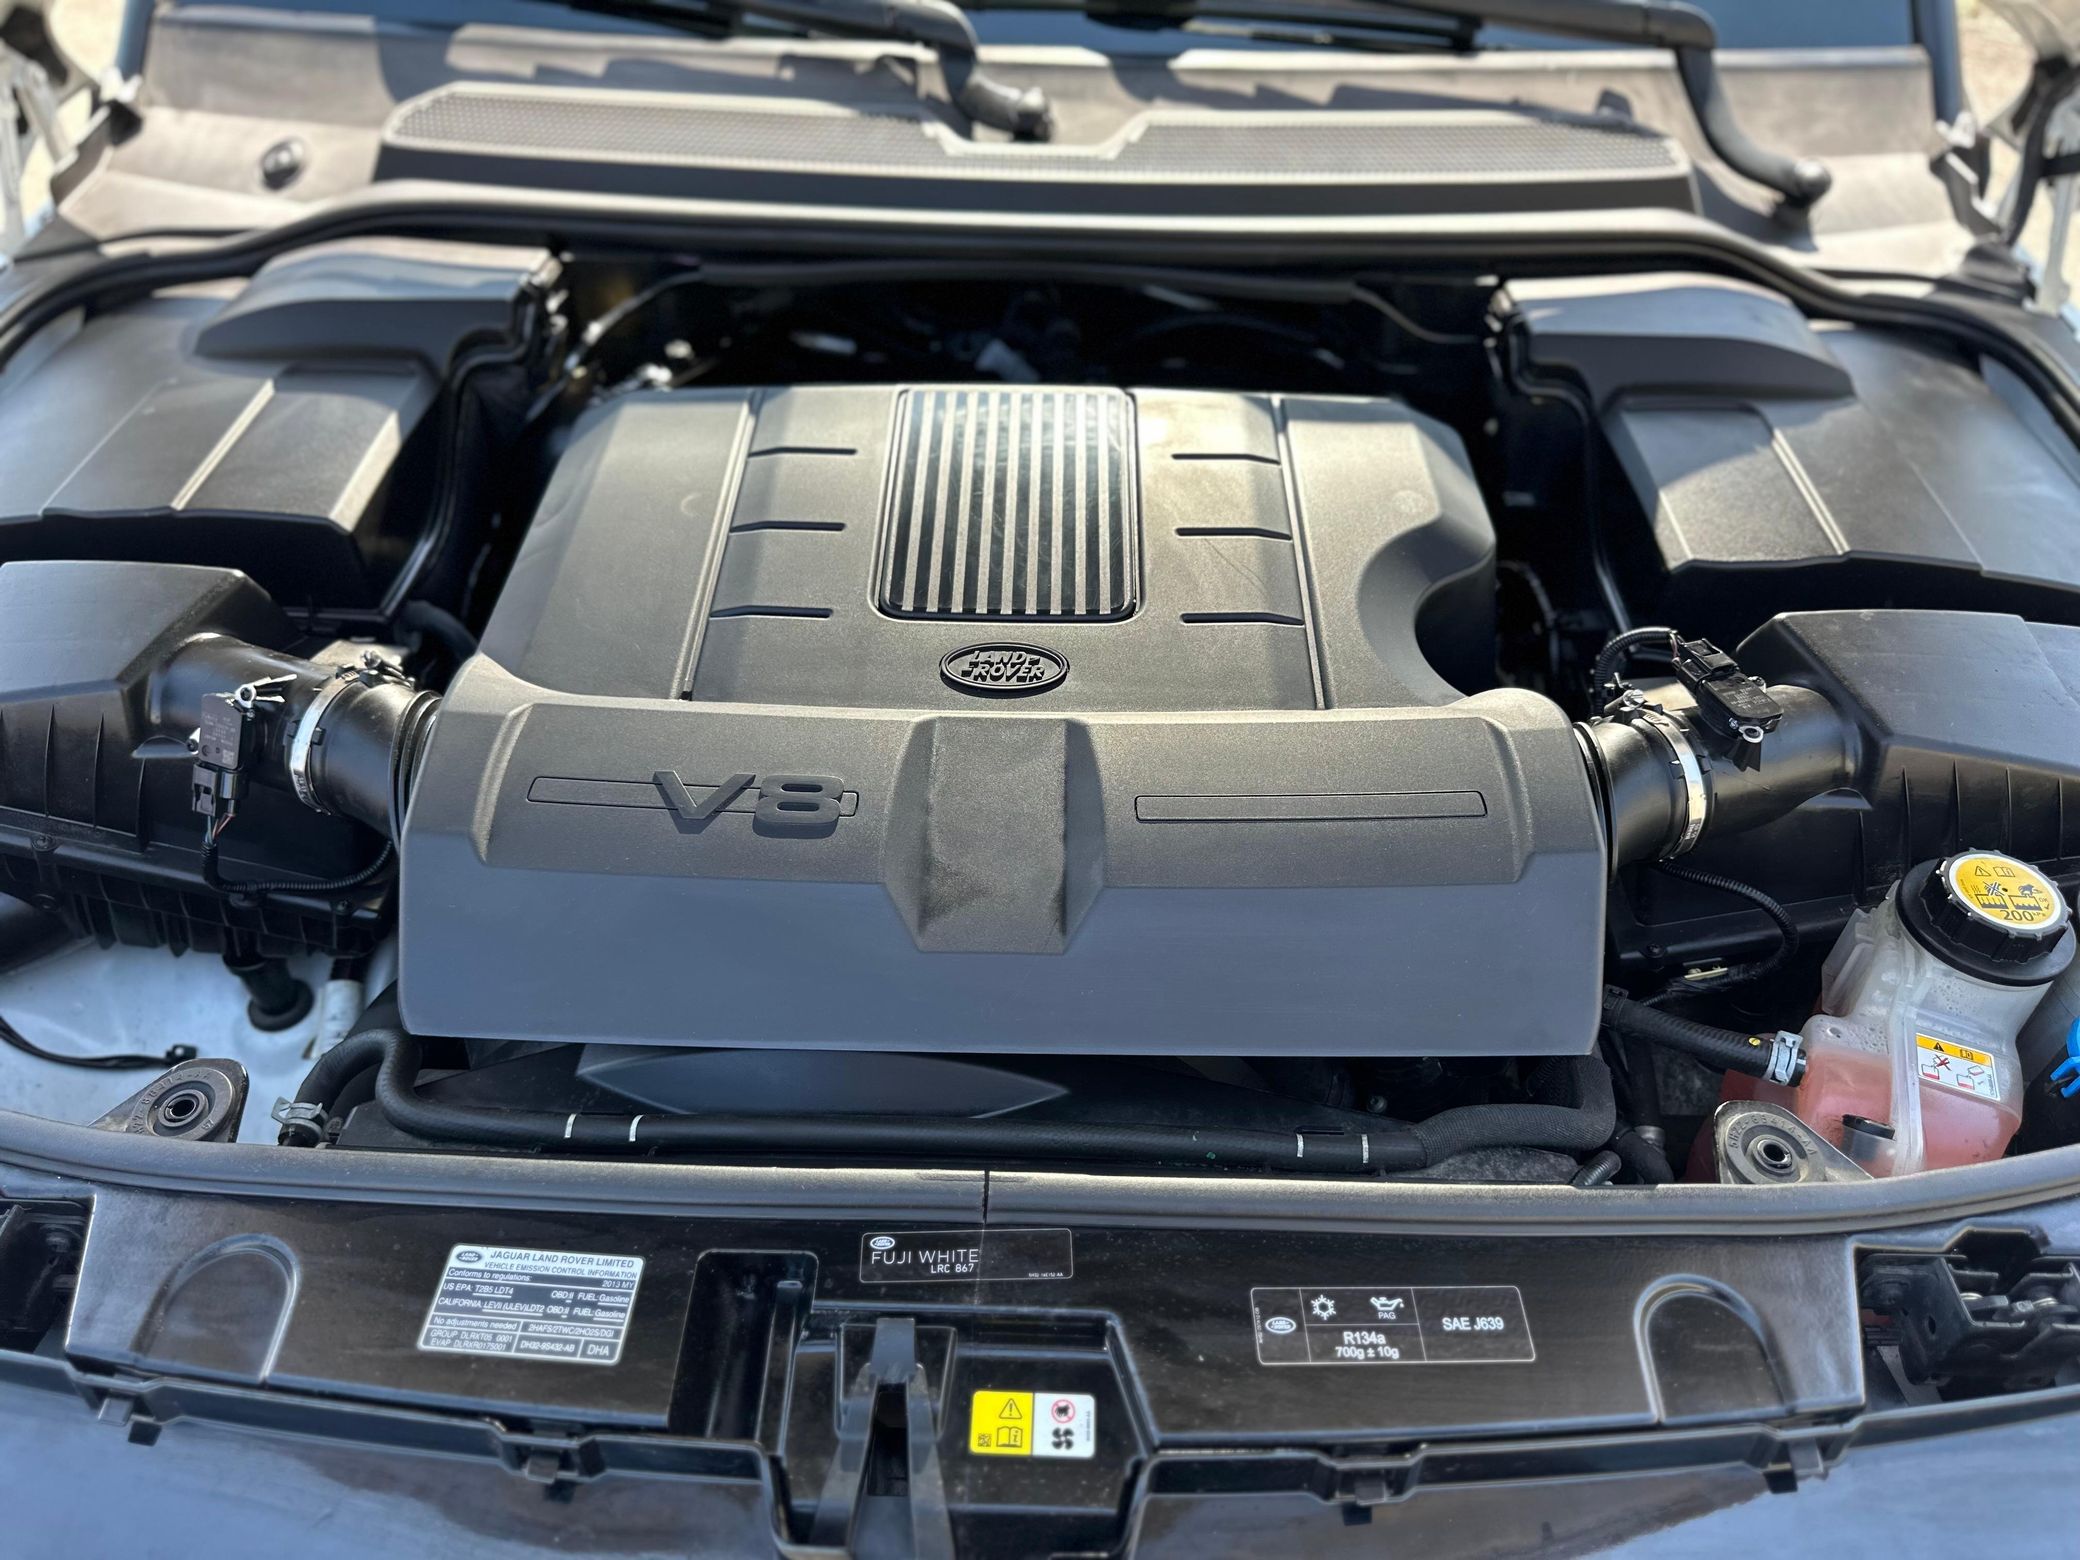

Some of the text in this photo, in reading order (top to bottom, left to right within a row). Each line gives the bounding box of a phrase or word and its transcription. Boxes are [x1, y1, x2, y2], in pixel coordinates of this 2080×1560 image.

[968, 650, 1029, 666] LAND
[969, 664, 1045, 682] ROVER
[652, 769, 845, 839] V8
[2000, 909, 2034, 922] 200
[490, 1250, 634, 1268] JAGUAR LAND ROVER LIMITED
[871, 1249, 980, 1265] FUJI WHITE
[448, 1268, 482, 1278] Conforms
[485, 1261, 638, 1279] VEHICLE EMISSION CONTROL INFORMATION
[930, 1263, 975, 1274] LRC 867
[443, 1282, 455, 1291] US
[474, 1284, 493, 1293] T2B5
[494, 1286, 514, 1295] LDT4
[602, 1280, 635, 1289] 2013 MY
[1378, 1312, 1396, 1320] PAG
[433, 1316, 518, 1331] No adjustments needed
[1442, 1316, 1505, 1332] SAE J639
[430, 1329, 459, 1338] GROUP
[1342, 1331, 1387, 1346] R134a
[430, 1337, 451, 1346] EVAP
[586, 1344, 610, 1356] DHA
[1335, 1346, 1400, 1360] 700g ± 10g
